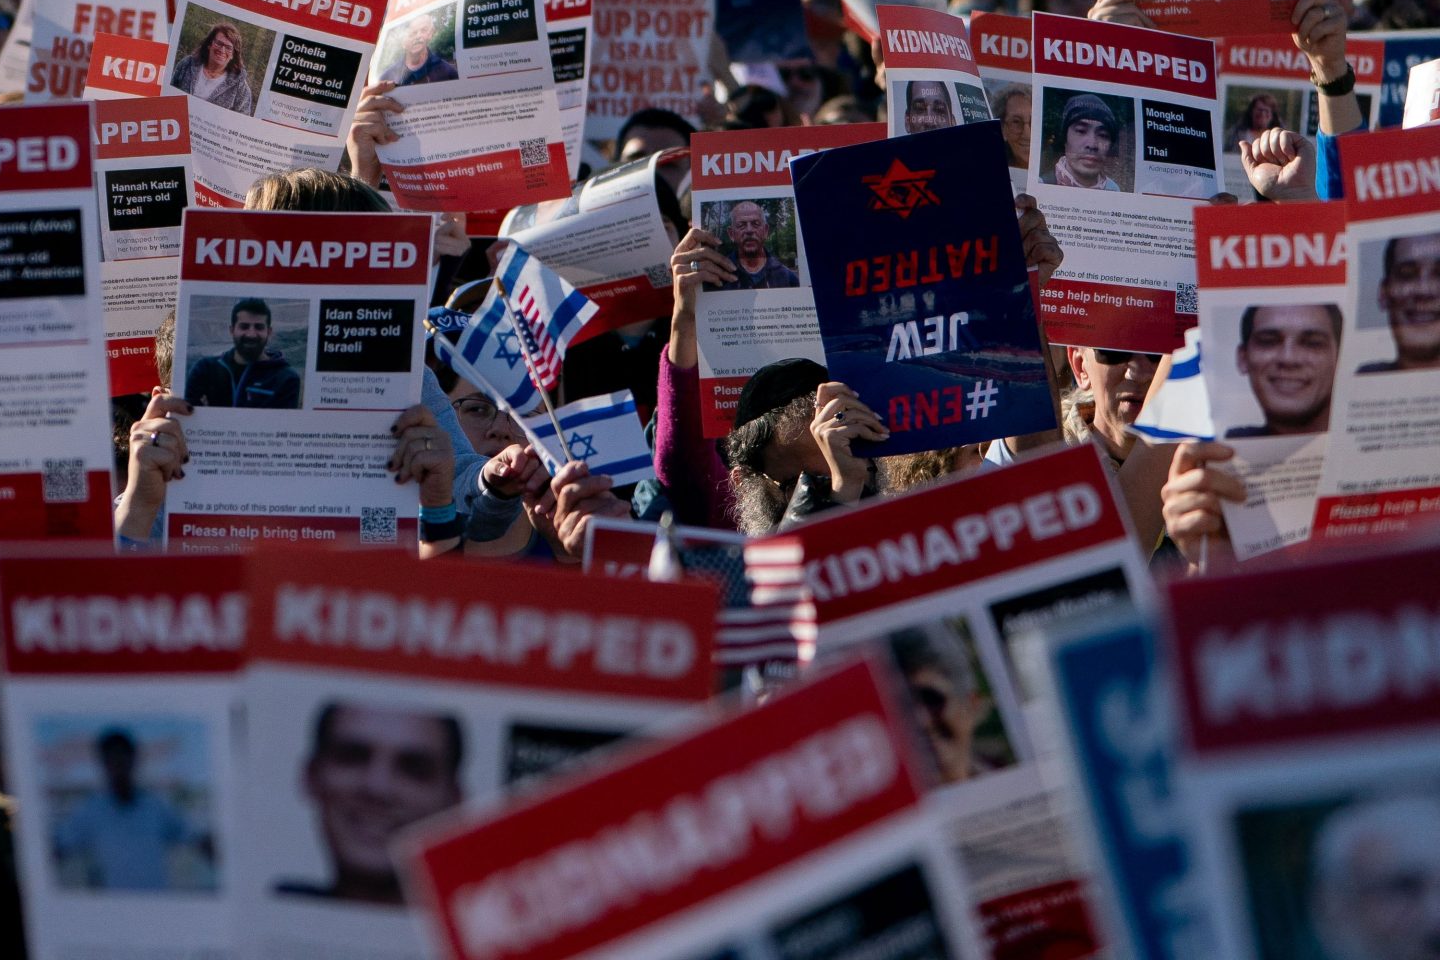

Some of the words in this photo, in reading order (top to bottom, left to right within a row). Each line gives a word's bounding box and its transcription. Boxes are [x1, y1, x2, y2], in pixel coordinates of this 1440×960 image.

[467, 1, 499, 14] Chaim
[73, 3, 156, 40] FREE
[467, 16, 480, 25] 79
[481, 11, 510, 26] years
[512, 8, 530, 19] old
[467, 26, 500, 38] Israeli
[285, 40, 327, 59] Ophelia
[886, 28, 972, 61] KIDNAPPED
[281, 53, 327, 72] Roitman
[1043, 38, 1207, 84] KIDNAPPED
[1230, 47, 1375, 74] KIDNAED
[279, 65, 292, 77] 77
[293, 71, 323, 86] years
[325, 79, 343, 90] old
[275, 77, 347, 100] Israeli-Argentinian
[310, 118, 333, 128] Hamas
[1145, 107, 1185, 122] Mongkol
[1146, 120, 1208, 139] Phachuabbun
[1147, 146, 1169, 158] Thai
[392, 170, 423, 181] Please
[424, 170, 447, 181] help
[447, 165, 475, 178] bring
[476, 161, 504, 174] them
[701, 149, 828, 176] KIDNA
[1193, 169, 1214, 180] Hamas
[111, 181, 149, 192] Hannah
[150, 180, 180, 190] Katzir
[423, 181, 449, 191] alive.
[112, 195, 124, 204] 77
[126, 193, 153, 205] years
[154, 192, 171, 202] old
[113, 206, 143, 216] Israeli
[195, 237, 418, 270] KIDNAPPED
[845, 235, 999, 297] HATRED
[1100, 274, 1123, 284] poster
[1140, 277, 1162, 287] share
[1067, 289, 1091, 302] help
[1093, 293, 1123, 307] bring
[1126, 297, 1154, 309] them
[325, 308, 353, 320] Idan
[356, 308, 392, 321] Shtivi
[1060, 304, 1089, 316] alive.
[324, 324, 340, 336] 28
[342, 326, 377, 339] years
[380, 324, 401, 336] old
[885, 312, 969, 363] JEW
[323, 341, 362, 353] Israeli
[269, 504, 298, 514] poster
[182, 524, 226, 537] Please
[230, 525, 259, 539] help
[262, 526, 298, 540] bring
[301, 527, 336, 539] them
[804, 481, 1105, 603] KIDNAPPED
[274, 584, 698, 680] KIDNAPPED
